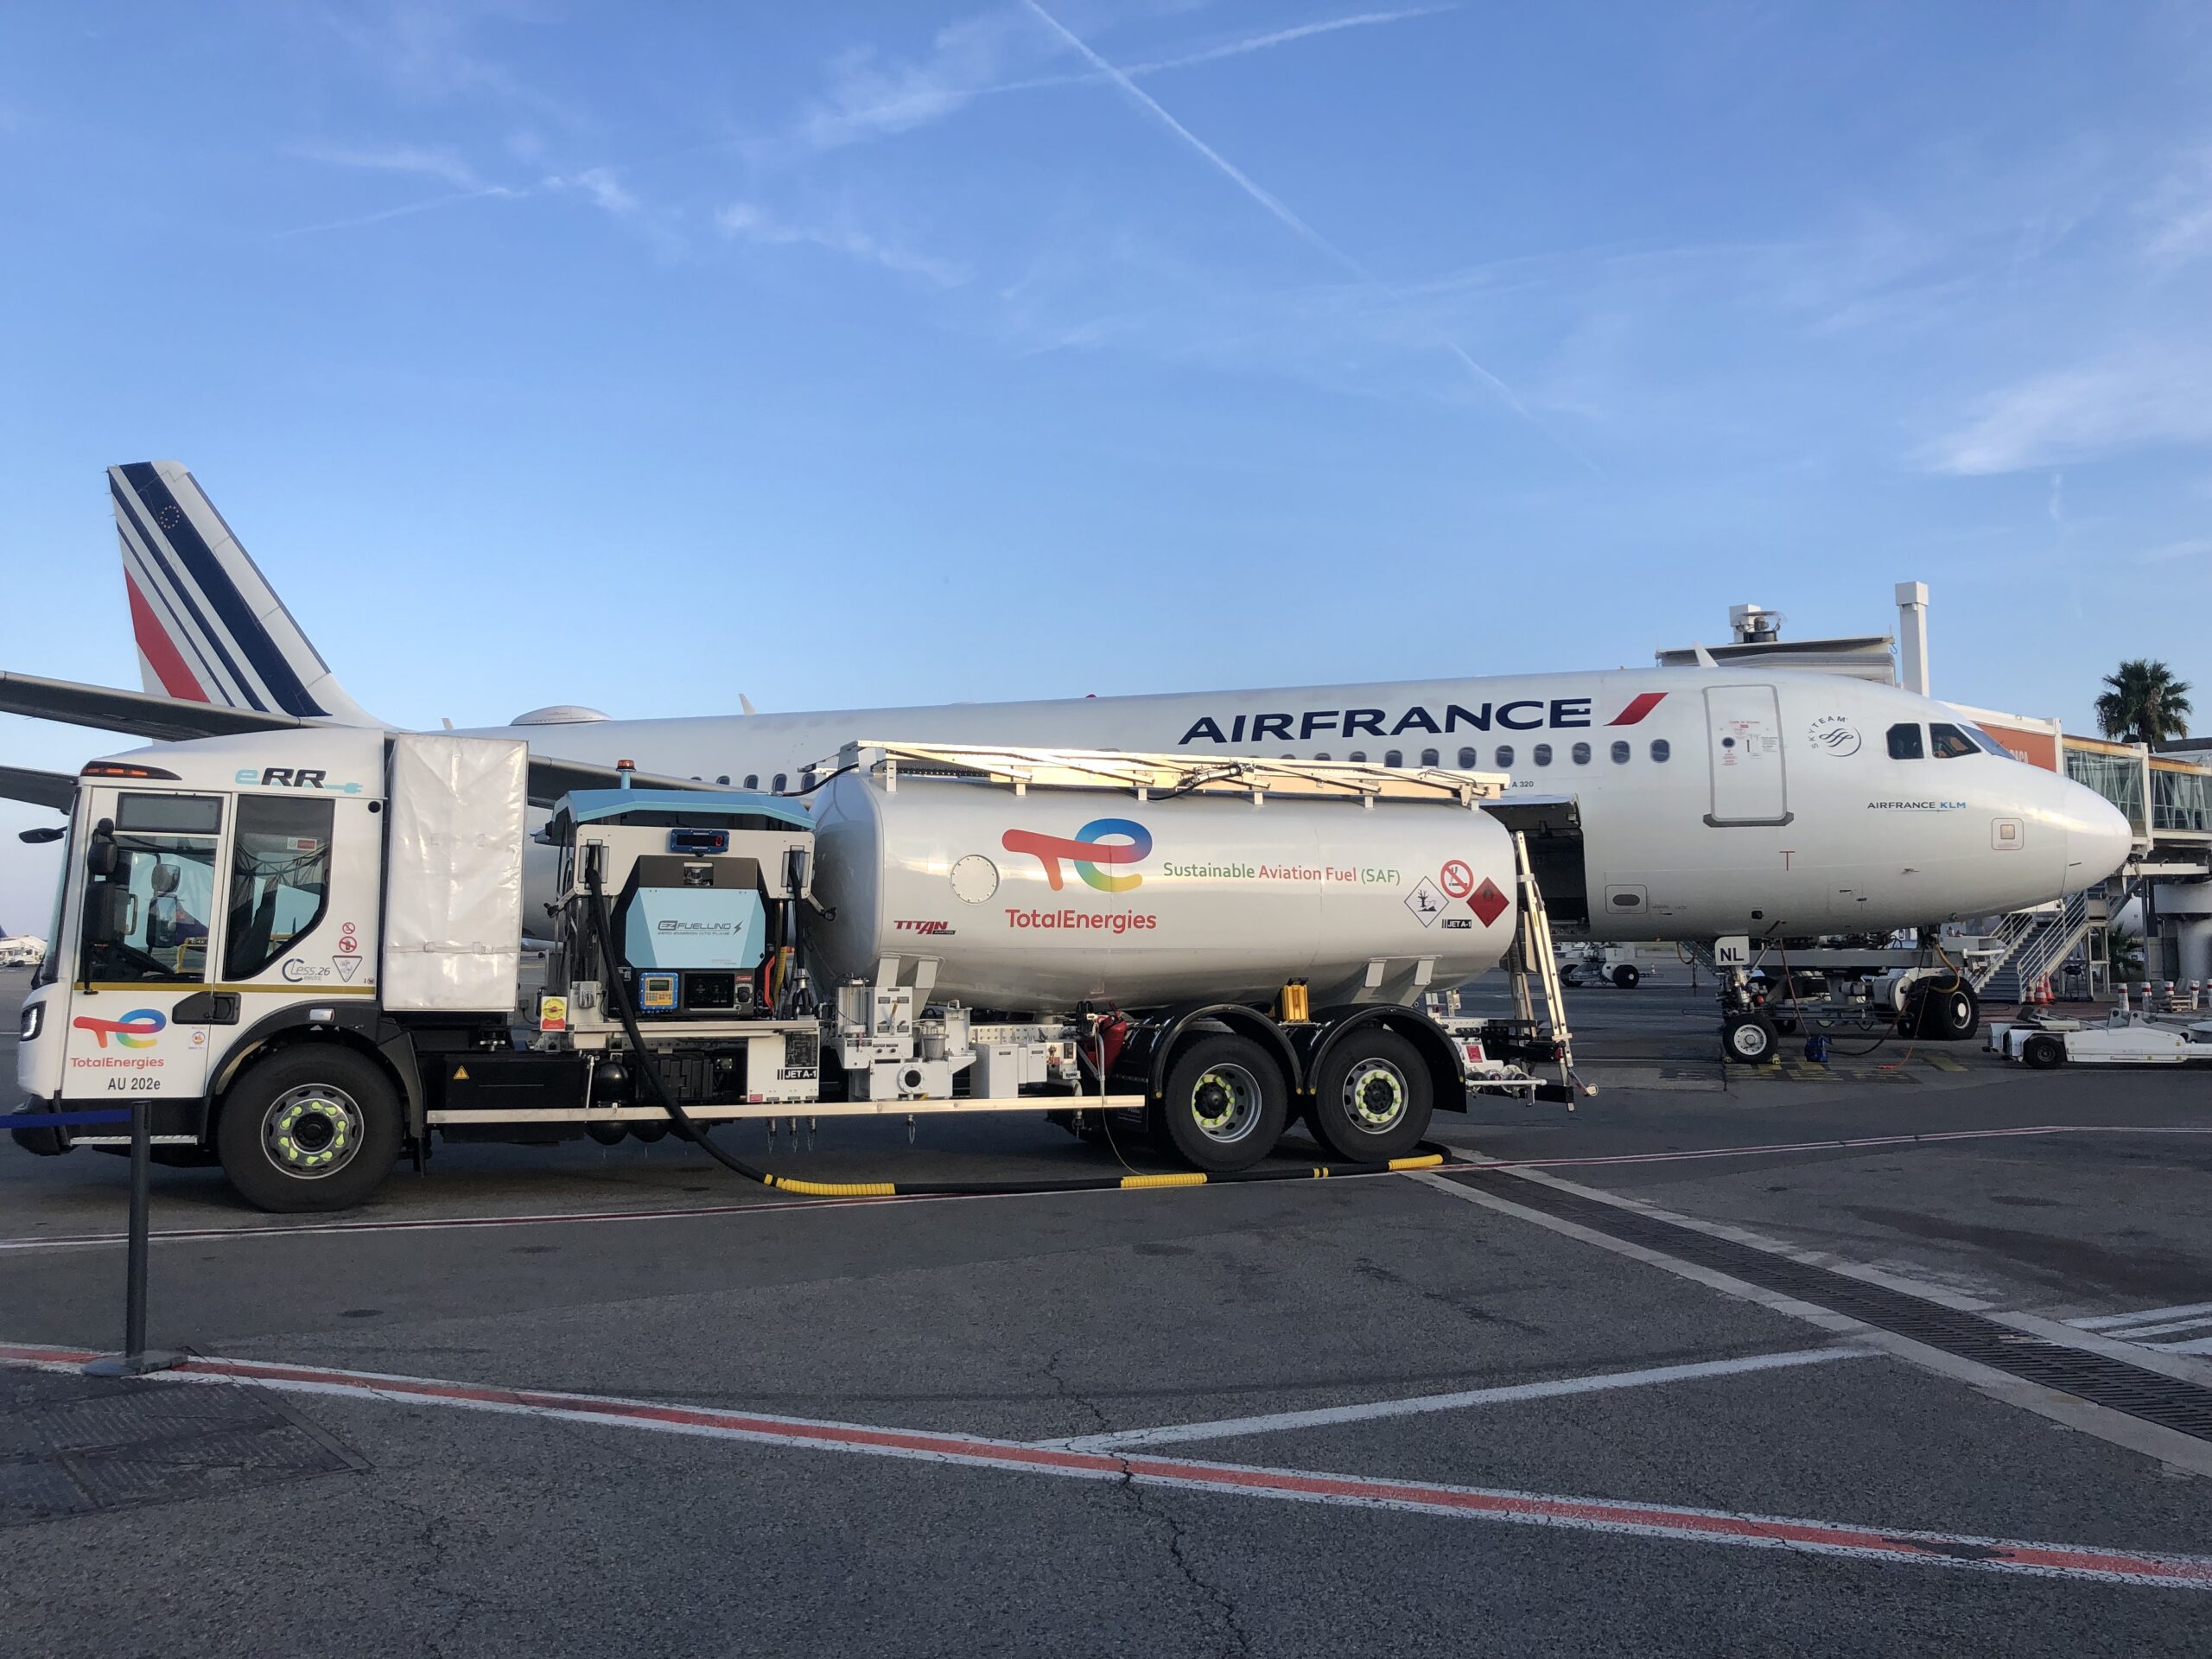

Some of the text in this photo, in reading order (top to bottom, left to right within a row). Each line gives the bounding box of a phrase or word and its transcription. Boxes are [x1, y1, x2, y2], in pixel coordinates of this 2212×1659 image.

[1178, 697, 1592, 746] AIRFRANCE
[1808, 715, 1846, 749] SKYTEAM
[1866, 801, 1967, 810] AIRFRANCE KLM
[1163, 861, 1401, 886] Sustainable Aviation Fuel (SAF)
[893, 920, 949, 935] TITAN
[1005, 909, 1157, 934] TotalEnergies
[1719, 947, 1745, 962] NL
[70, 1057, 165, 1070] TotalEnergies
[785, 1070, 817, 1079] JET A-1
[107, 1077, 162, 1090] AU 202e
